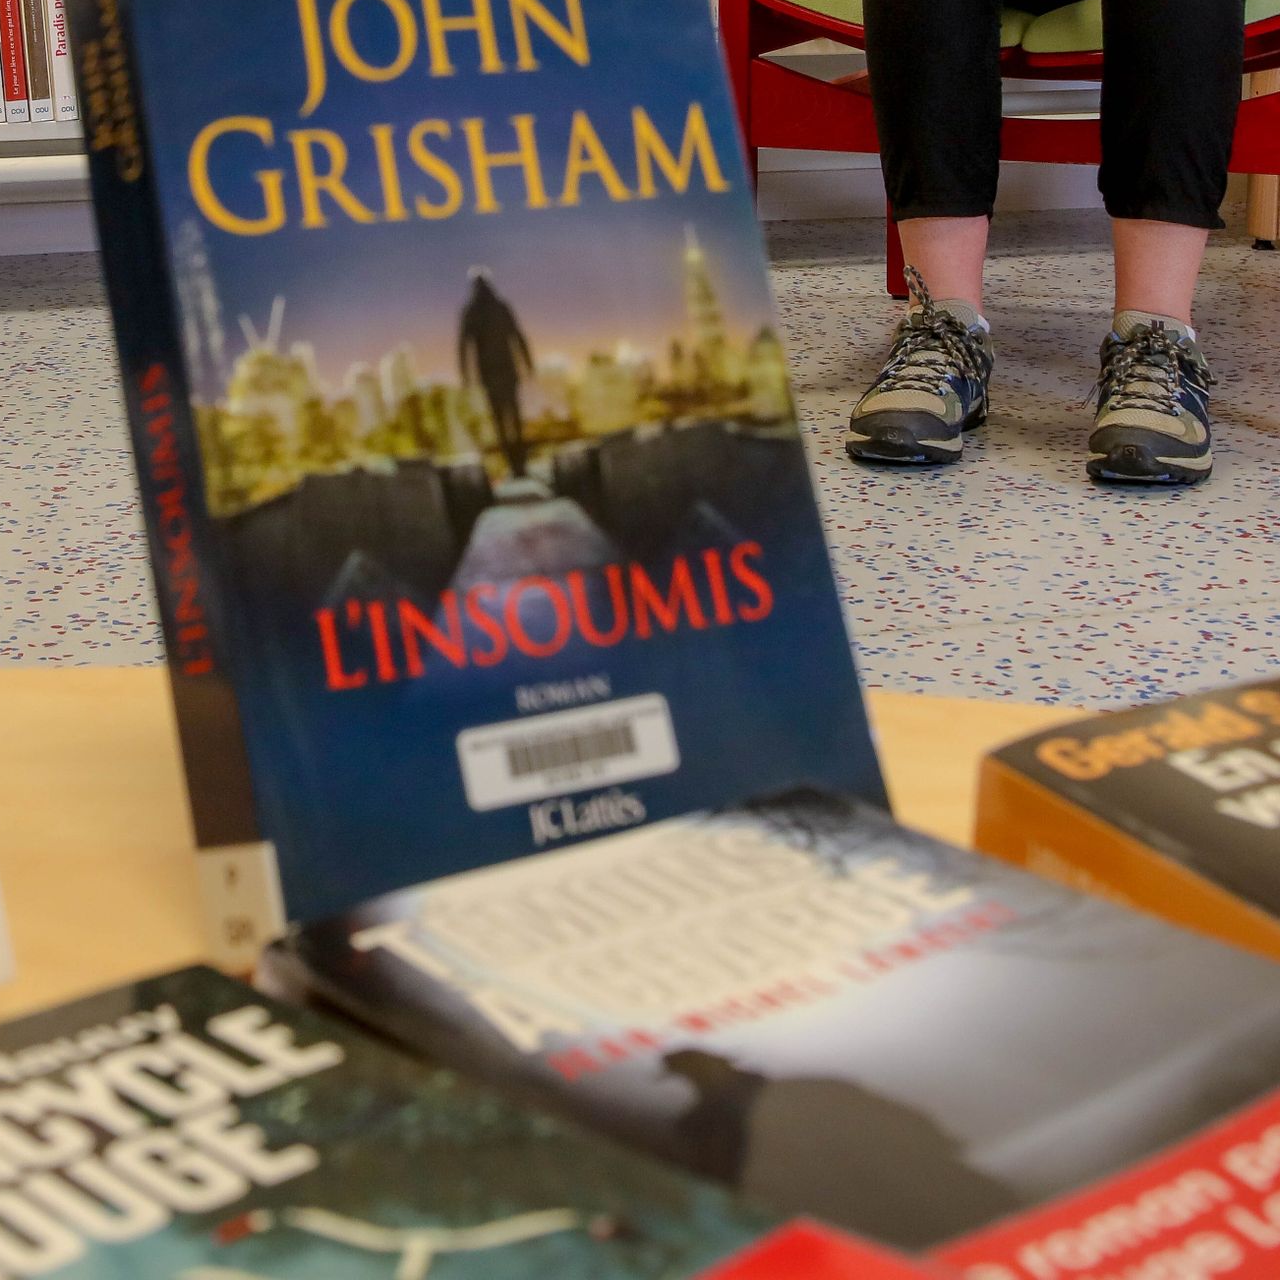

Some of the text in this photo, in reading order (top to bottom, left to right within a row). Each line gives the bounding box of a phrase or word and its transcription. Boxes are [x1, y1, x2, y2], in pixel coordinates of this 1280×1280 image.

[55, 11, 67, 57] Paradis
[188, 103, 729, 237] GRISHAM
[316, 542, 775, 691] L'INSOUMIS
[515, 674, 611, 713] ROMAN
[1036, 705, 1263, 781] Gerald
[1019, 1171, 1231, 1279] roman
